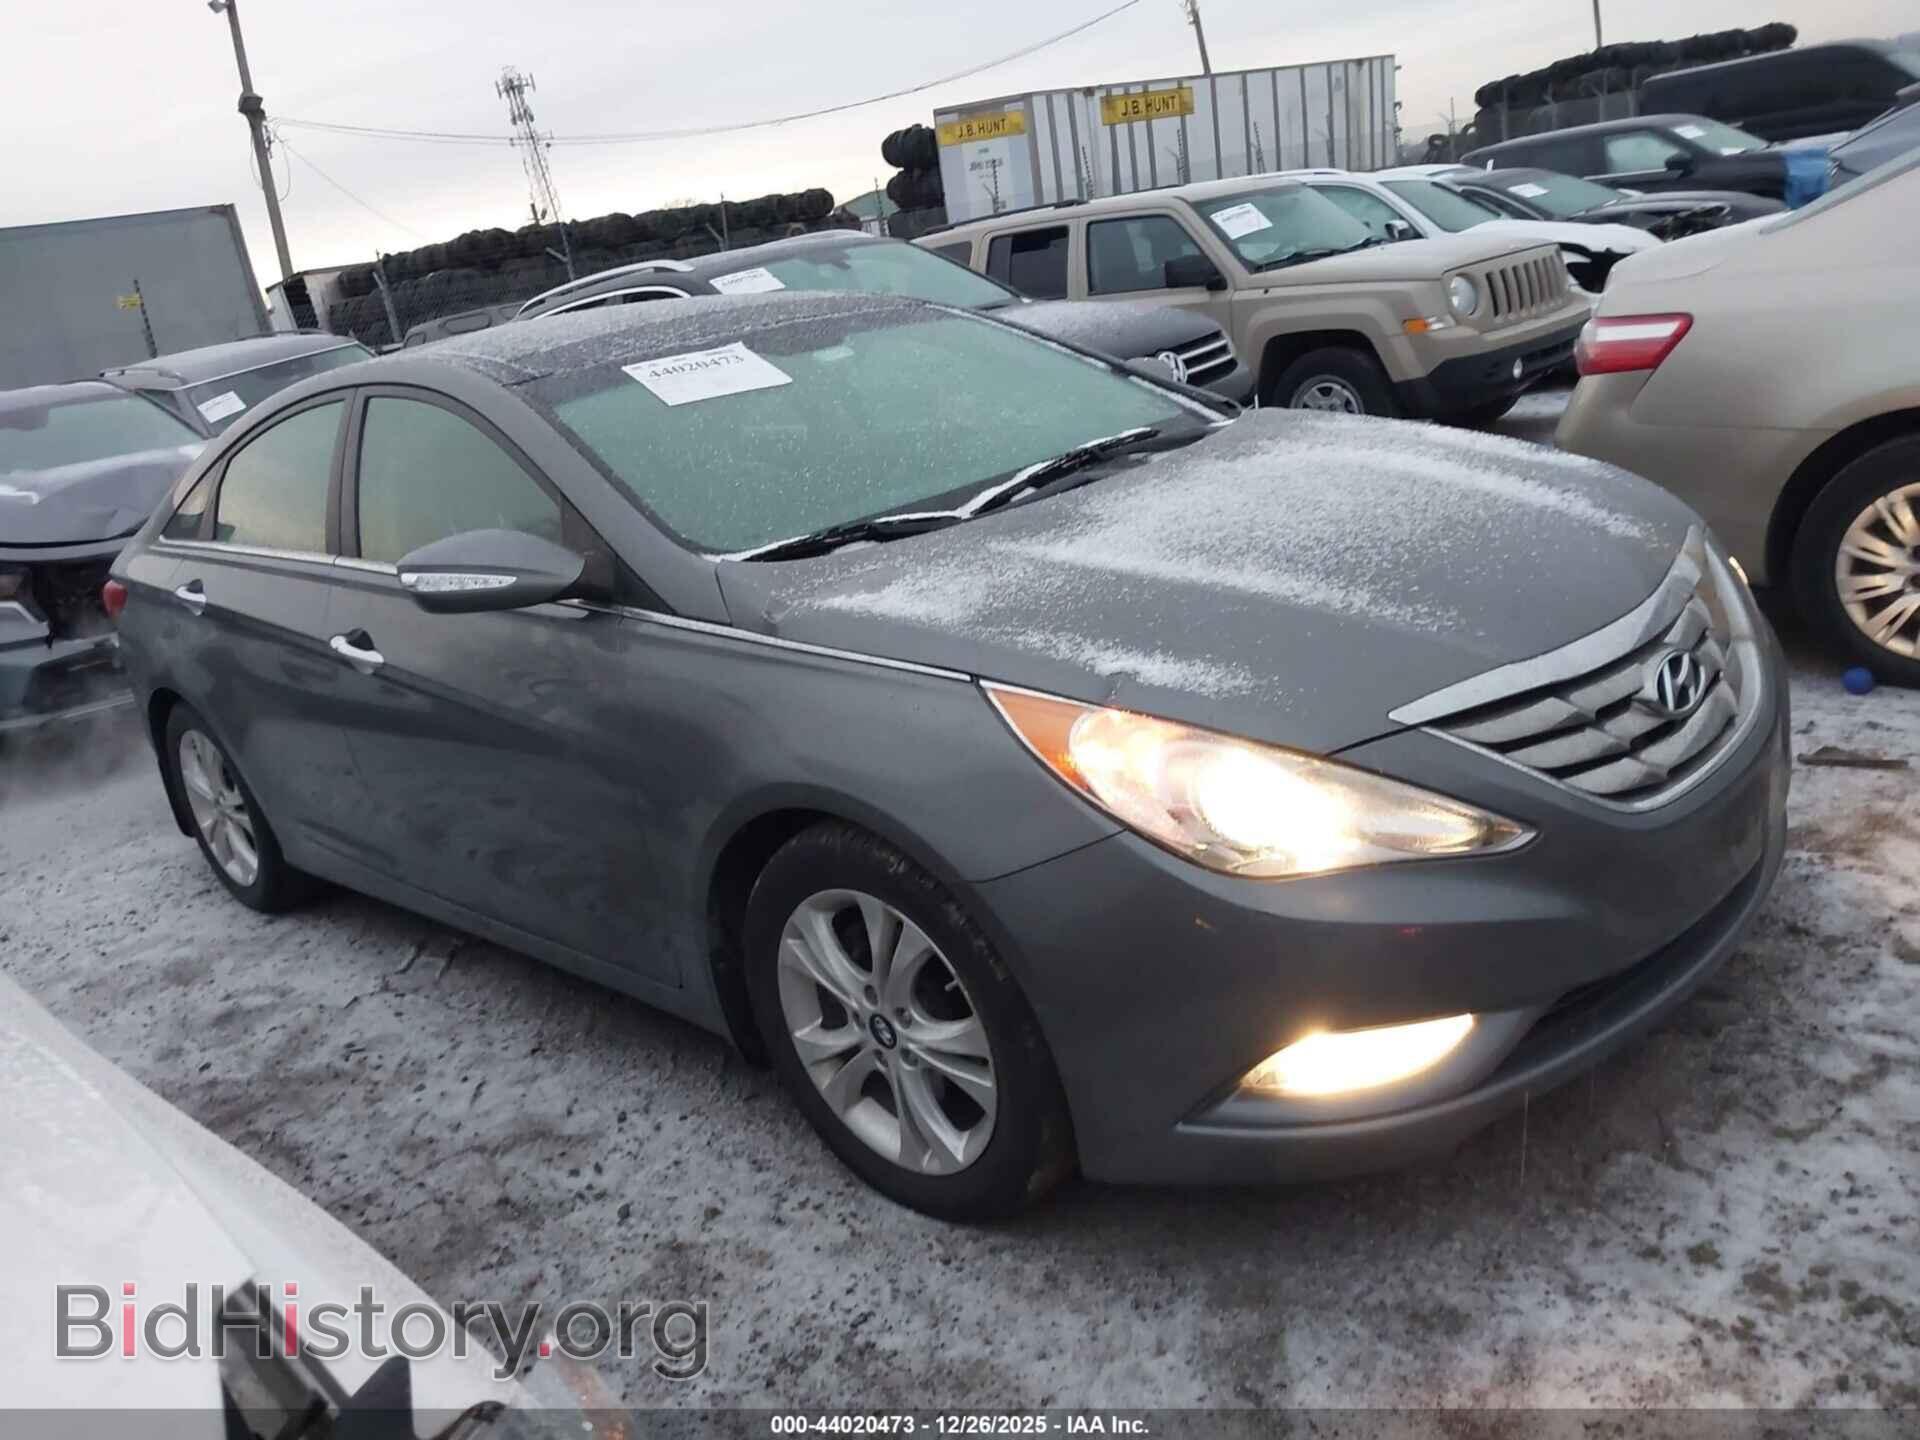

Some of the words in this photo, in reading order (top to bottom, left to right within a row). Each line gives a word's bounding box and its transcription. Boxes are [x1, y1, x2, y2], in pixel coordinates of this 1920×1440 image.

[1121, 99, 1144, 117] J.B.
[1145, 95, 1176, 113] HUNT
[958, 123, 977, 138] J.B.
[978, 117, 1007, 135] HUNT
